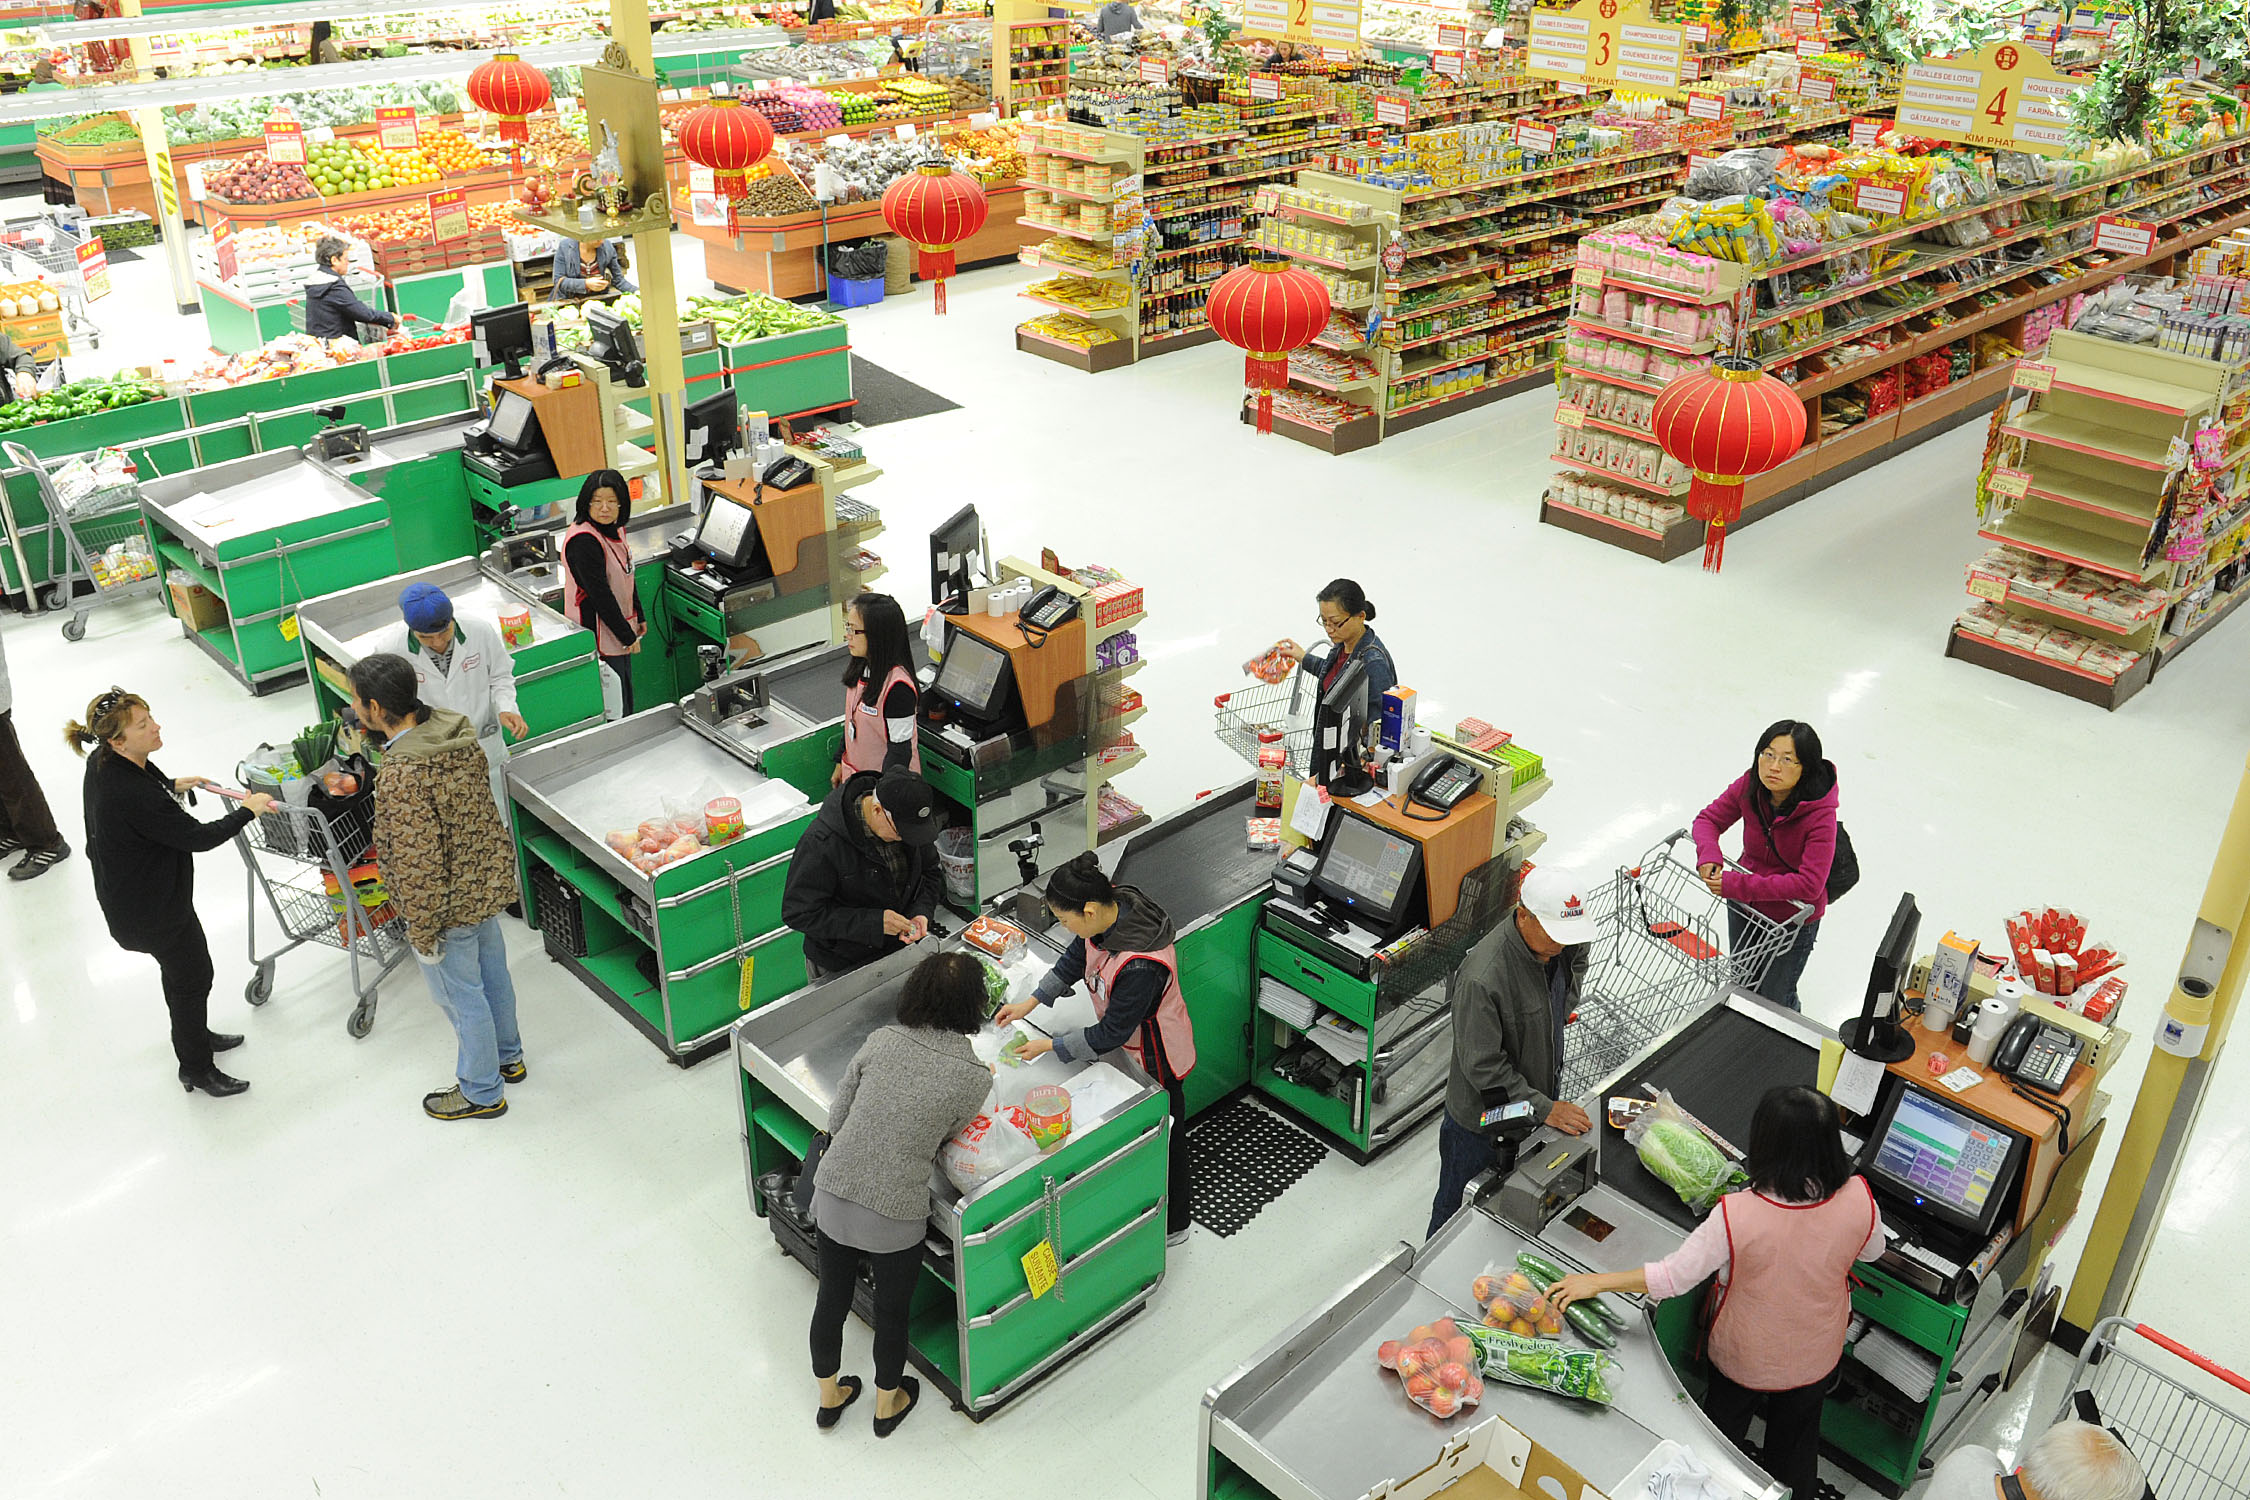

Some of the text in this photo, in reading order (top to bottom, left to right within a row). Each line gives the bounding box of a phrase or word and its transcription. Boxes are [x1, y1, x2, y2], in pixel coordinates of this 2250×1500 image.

[1295, 0, 1307, 26] 2
[1283, 33, 1296, 41] KIM
[1595, 32, 1610, 66] 3
[1547, 60, 1568, 68] BAMBOU
[1580, 74, 1619, 87] KIM PHAT
[1913, 69, 1942, 79] FEUILLES
[1953, 75, 1974, 83] LOTUS
[1906, 90, 1928, 98] FEUILLES
[2027, 84, 2065, 95] NOUILLES
[1985, 86, 2008, 126] 4
[2028, 106, 2055, 117] FARINE
[1910, 113, 1939, 123] GÂTEAUX
[1951, 119, 1961, 127] RIZ
[1965, 133, 2016, 148] KIM PHAT
[2025, 130, 2056, 140] FEUILLES
[2020, 360, 2042, 370] SPECIAL
[1997, 468, 2018, 477] SPECIAL
[1975, 571, 1997, 582] SPECIAL
[1686, 1113, 1735, 1151] LES ALIMENTS
[1042, 1247, 1058, 1277] CAISSE
[1031, 1251, 1049, 1290] SUIVANTE
[1488, 1335, 1555, 1352] Fresh Celery
